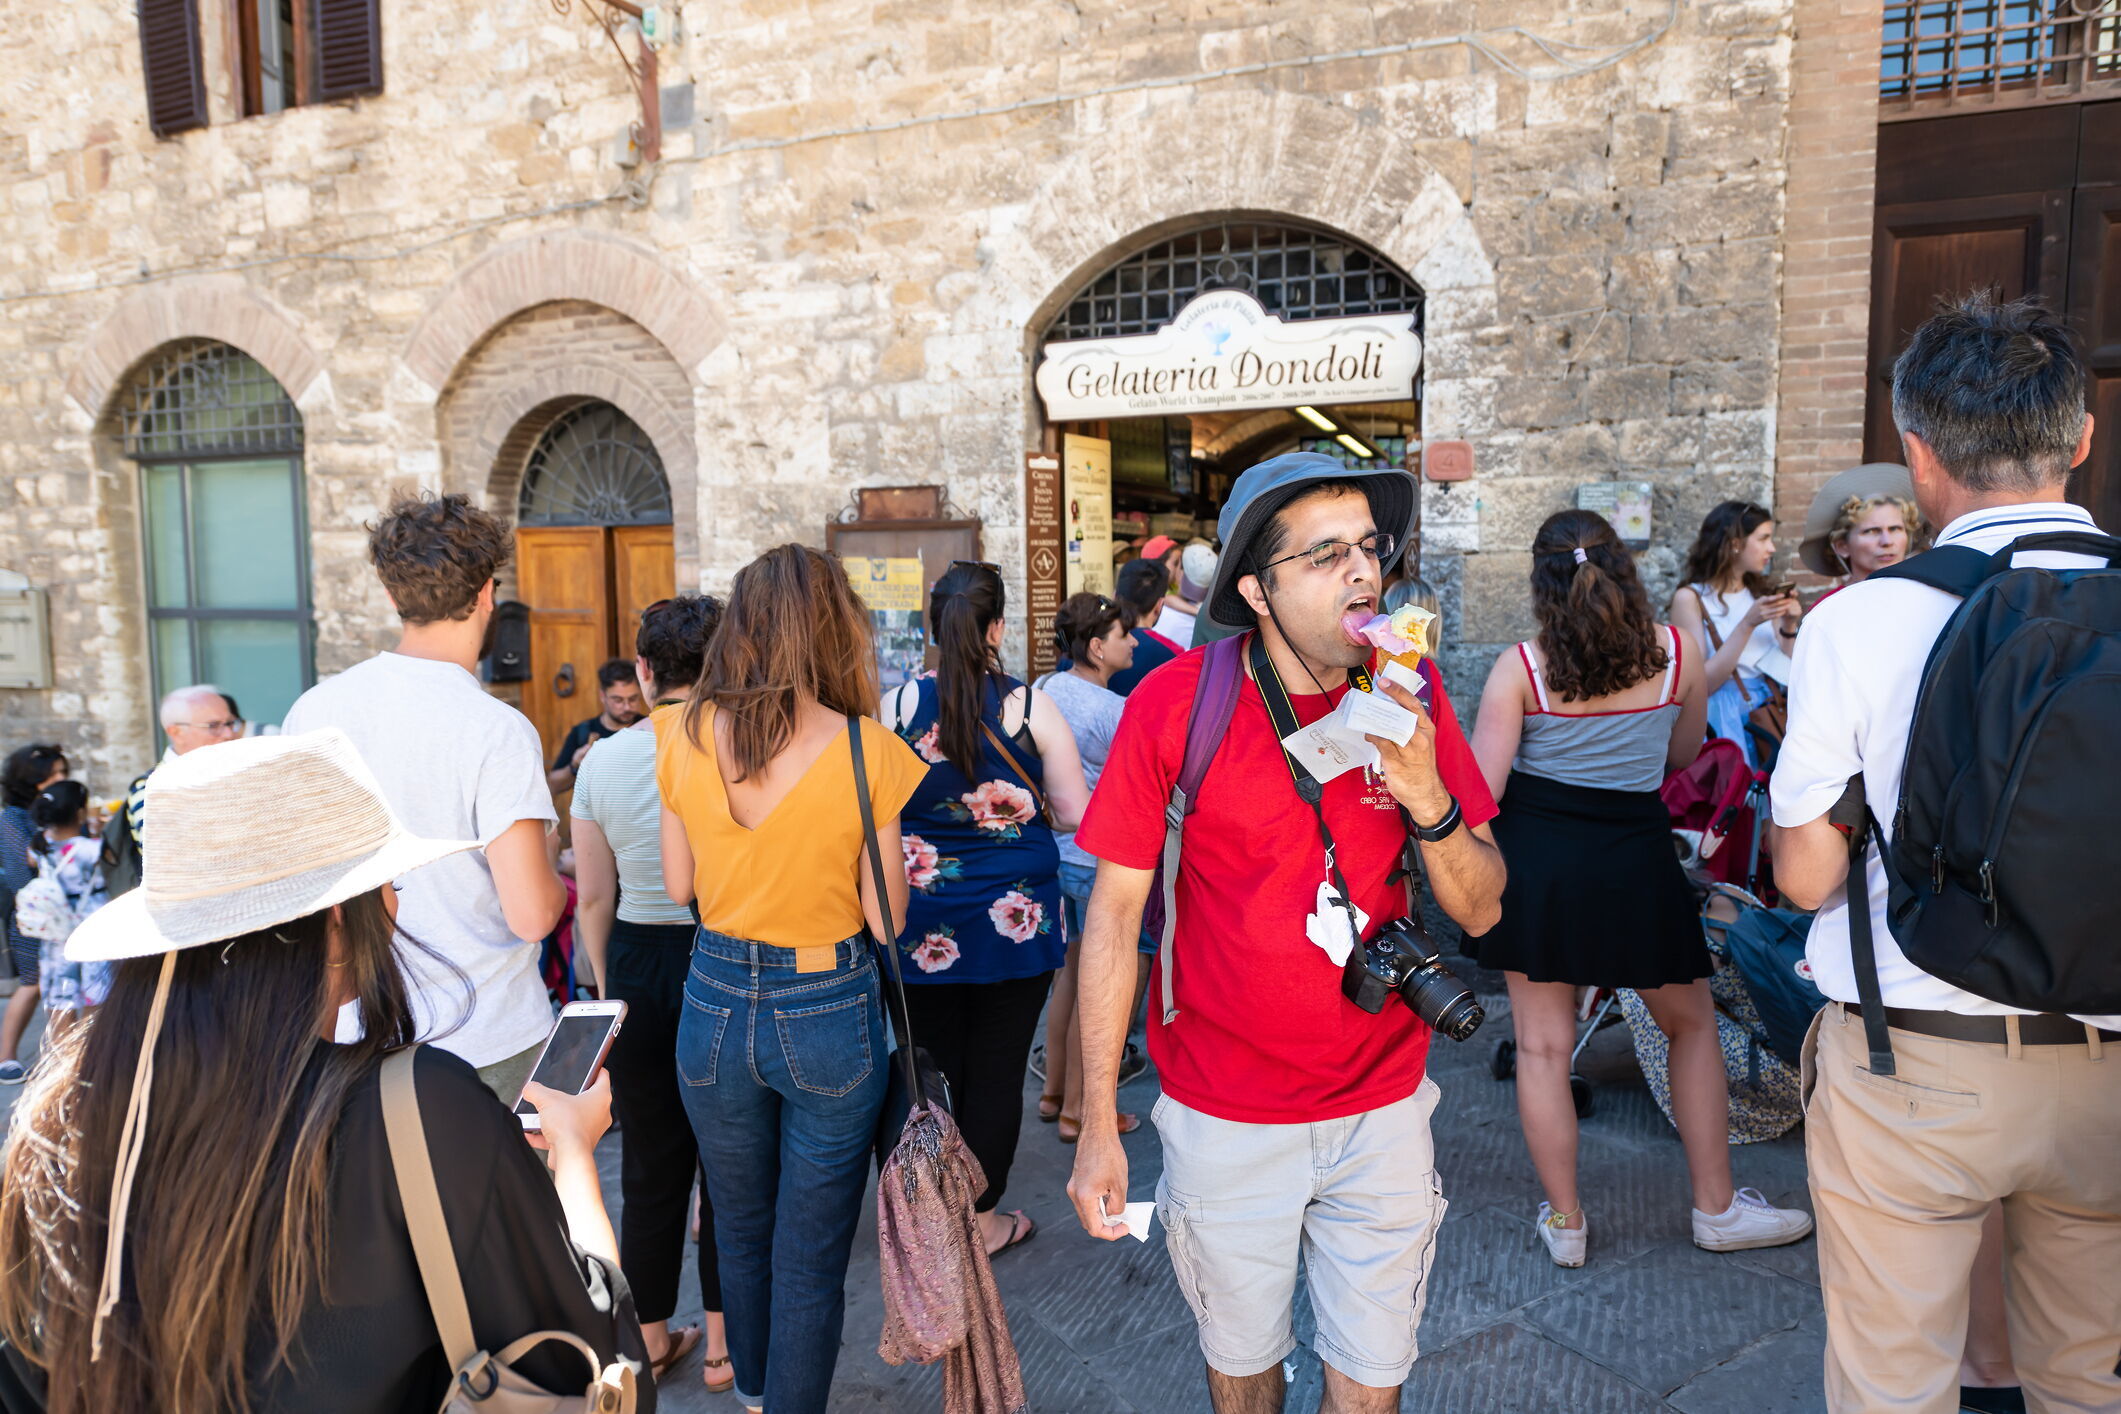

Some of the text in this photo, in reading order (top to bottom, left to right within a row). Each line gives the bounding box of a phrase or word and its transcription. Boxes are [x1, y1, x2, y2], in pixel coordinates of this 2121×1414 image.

[1067, 341, 1384, 400] Gelateria Dondoli
[1128, 397, 1158, 409] Gelato
[1159, 395, 1187, 407] World
[1190, 393, 1237, 406] Champion
[1034, 617, 1055, 630] 2016
